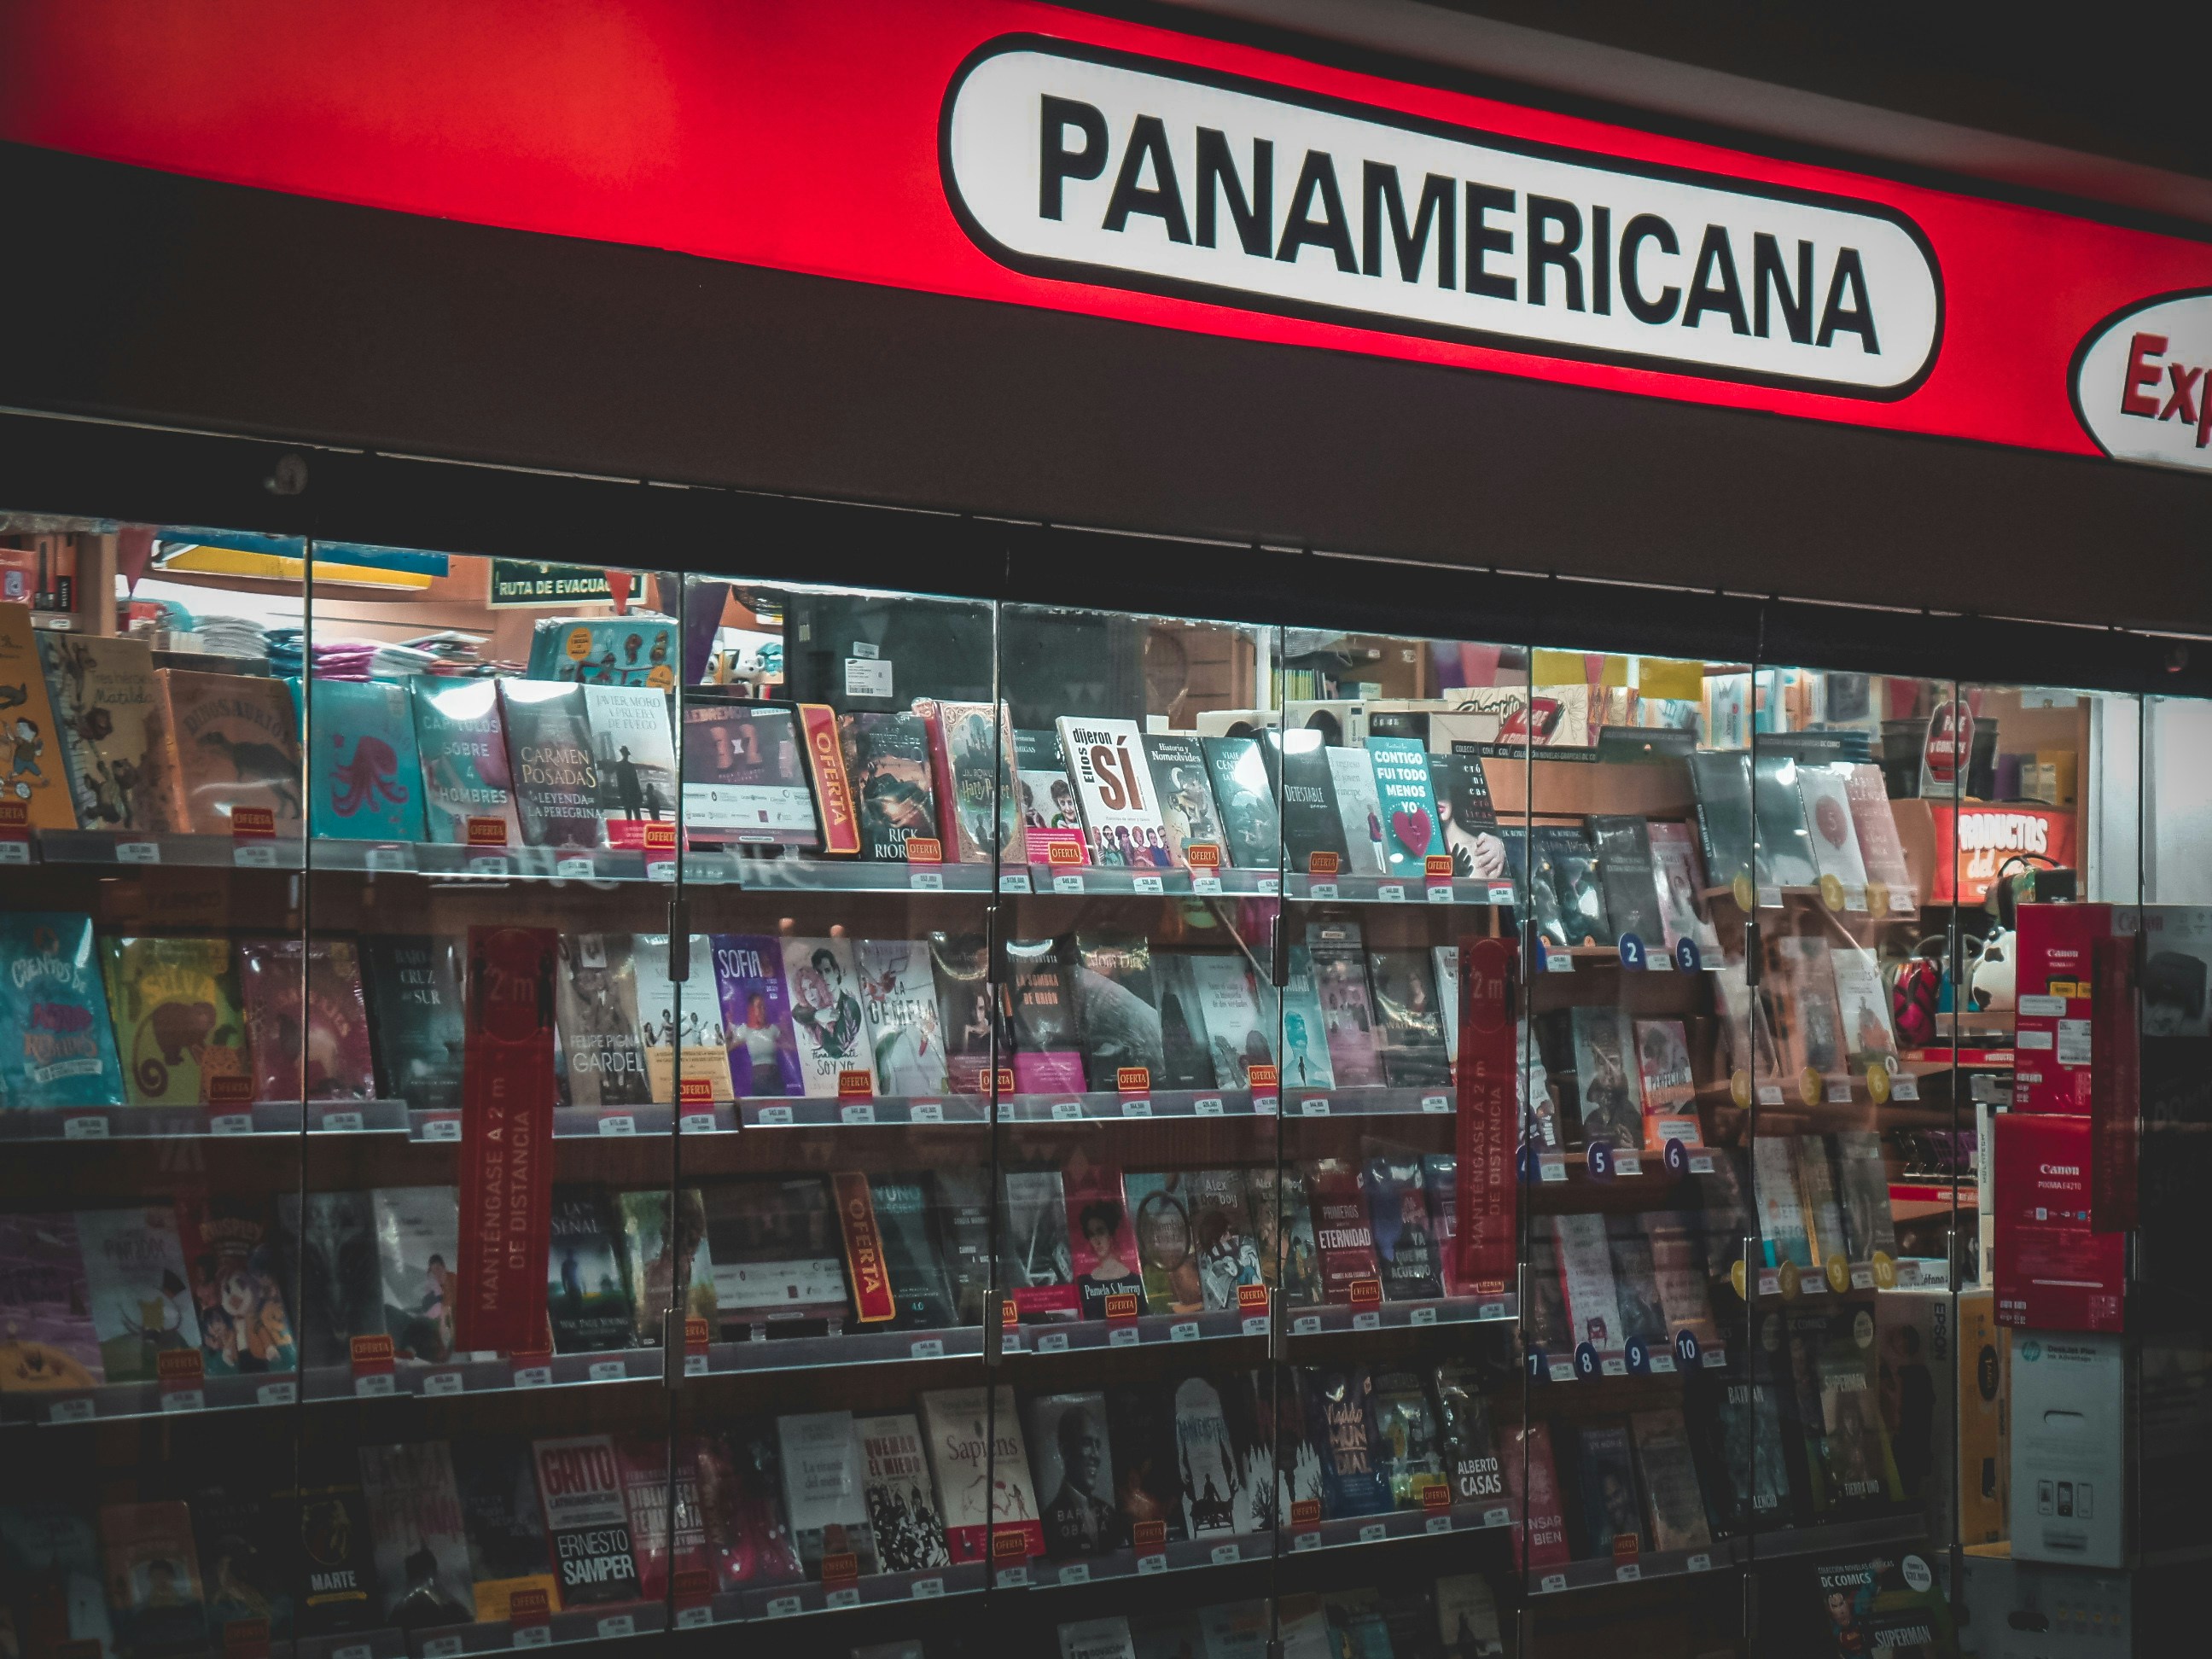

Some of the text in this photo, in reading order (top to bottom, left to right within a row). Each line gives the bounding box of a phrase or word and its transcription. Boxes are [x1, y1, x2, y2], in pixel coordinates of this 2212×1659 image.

[1039, 94, 1881, 356] PANAMERICANA
[499, 580, 533, 597] RUTA
[536, 580, 553, 596] DE
[1072, 728, 1112, 748] dijeron
[444, 742, 490, 758] SOBRE
[521, 746, 589, 765] CARMEN
[1158, 742, 1183, 753] Historia
[1151, 750, 1201, 762] Nomeolvides
[1375, 750, 1423, 766] CONTIGO
[1082, 747, 1096, 783] Ellos
[1091, 735, 1143, 811] SÍ
[522, 765, 597, 789] POSADAS
[816, 731, 848, 826] OFERTA
[1377, 766, 1427, 782] FUI TODO
[439, 789, 508, 805] HOMBRES
[962, 778, 985, 801] Harry
[1284, 784, 1324, 803] DETESTABLE
[1386, 783, 1426, 797] MENOS
[538, 792, 588, 806] LEYENDA
[1400, 800, 1417, 813] YO
[235, 813, 273, 825] OFERTA
[544, 806, 602, 818] PEREGRINA
[471, 825, 504, 836] OFERTA
[889, 828, 918, 841] RICK
[908, 844, 938, 856] OFERTA
[1051, 847, 1080, 859] OFERTA
[1190, 850, 1218, 862] OFERTA
[1312, 857, 1336, 869] OFERTA
[1427, 859, 1452, 871] OFERTA
[1627, 942, 1638, 963] 2
[1683, 946, 1693, 967] 3
[2046, 948, 2079, 958] Canon
[490, 971, 505, 1002] 2
[570, 1033, 604, 1049] FELIPE
[573, 1052, 645, 1073] GARDEL
[817, 1059, 837, 1075] SOY
[841, 1075, 870, 1087] OFERTA
[1120, 1073, 1147, 1084] OFERTA
[1250, 1070, 1277, 1081] OFERTA
[1471, 1060, 1486, 1250] MANTÉNGASE A 2 m
[1488, 1086, 1502, 1216] DE DISTANCIA
[1670, 1147, 1680, 1167] 6
[1595, 1152, 1605, 1173] 5
[2040, 1163, 2081, 1176] Canon
[509, 1110, 531, 1270] DE DISTANCIA
[1206, 1179, 1227, 1191] Alex
[480, 1079, 506, 1311] MANTÉNGASE A 2 m
[1322, 1205, 1359, 1220] PRIMEROS
[849, 1198, 880, 1295] OFERTA
[1318, 1228, 1371, 1249] ETERNIDAD
[1411, 1231, 1426, 1246] YA
[1832, 1267, 1842, 1286] 9
[1875, 1261, 1890, 1282] 10
[1085, 1285, 1113, 1300] Pamela
[1120, 1283, 1141, 1296] Murray
[1240, 1289, 1266, 1301] OFERTA
[1353, 1286, 1378, 1296] OFERTA
[1109, 1300, 1134, 1312] OFERTA
[1933, 1302, 1947, 1361] EPSON
[353, 1342, 389, 1353] OFERTA
[1678, 1339, 1697, 1359] 10
[160, 1357, 199, 1369] OFERTA
[1528, 1353, 1539, 1376] 7
[1580, 1352, 1592, 1373] 8
[1631, 1347, 1641, 1367] 9
[541, 1447, 618, 1495] GRITO
[1336, 1451, 1373, 1475] DIAL
[1457, 1457, 1499, 1476] ALBERTO
[1459, 1473, 1502, 1497] CASAS
[1425, 1490, 1448, 1501] OFERTA
[1293, 1505, 1318, 1517] OFERTA
[1136, 1527, 1163, 1539] OFERTA
[1533, 1531, 1563, 1546] BIEN
[557, 1533, 630, 1557] ERNESTO
[995, 1538, 1024, 1550] OFERTA
[562, 1554, 636, 1586] SAMPER
[824, 1560, 855, 1572] OFERTA
[311, 1569, 357, 1592] MARTE
[1820, 1572, 1873, 1588] DC COMICS
[1874, 1625, 1932, 1648] SUPERMAN
